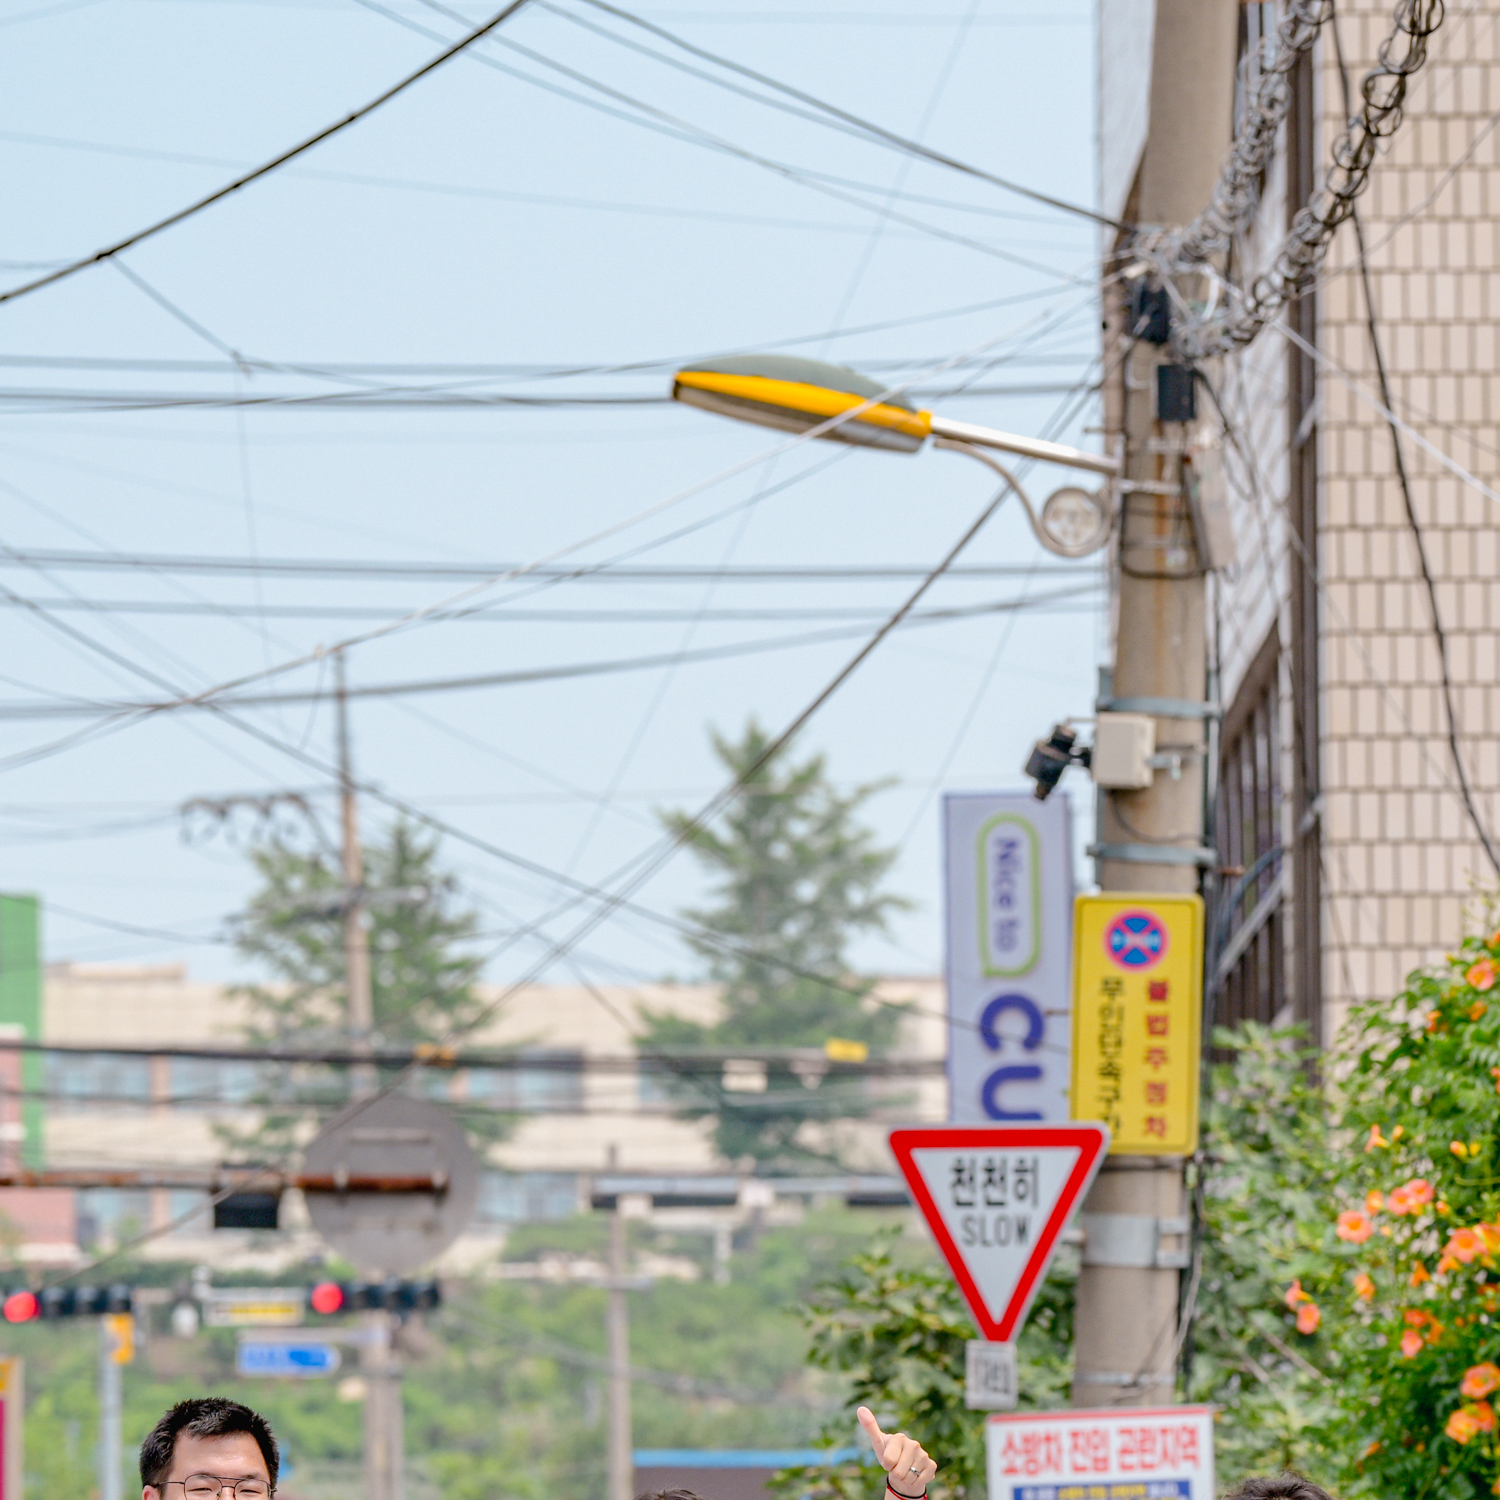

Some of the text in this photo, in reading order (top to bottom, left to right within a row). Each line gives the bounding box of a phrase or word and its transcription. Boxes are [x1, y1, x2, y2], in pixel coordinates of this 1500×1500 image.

[993, 836, 1021, 953] Nice to
[980, 994, 1045, 1121] CU
[949, 1155, 1041, 1209] 천천히
[961, 1214, 1031, 1247] SLOW
[1001, 1424, 1200, 1476] 소방차 진입 곤란지역
